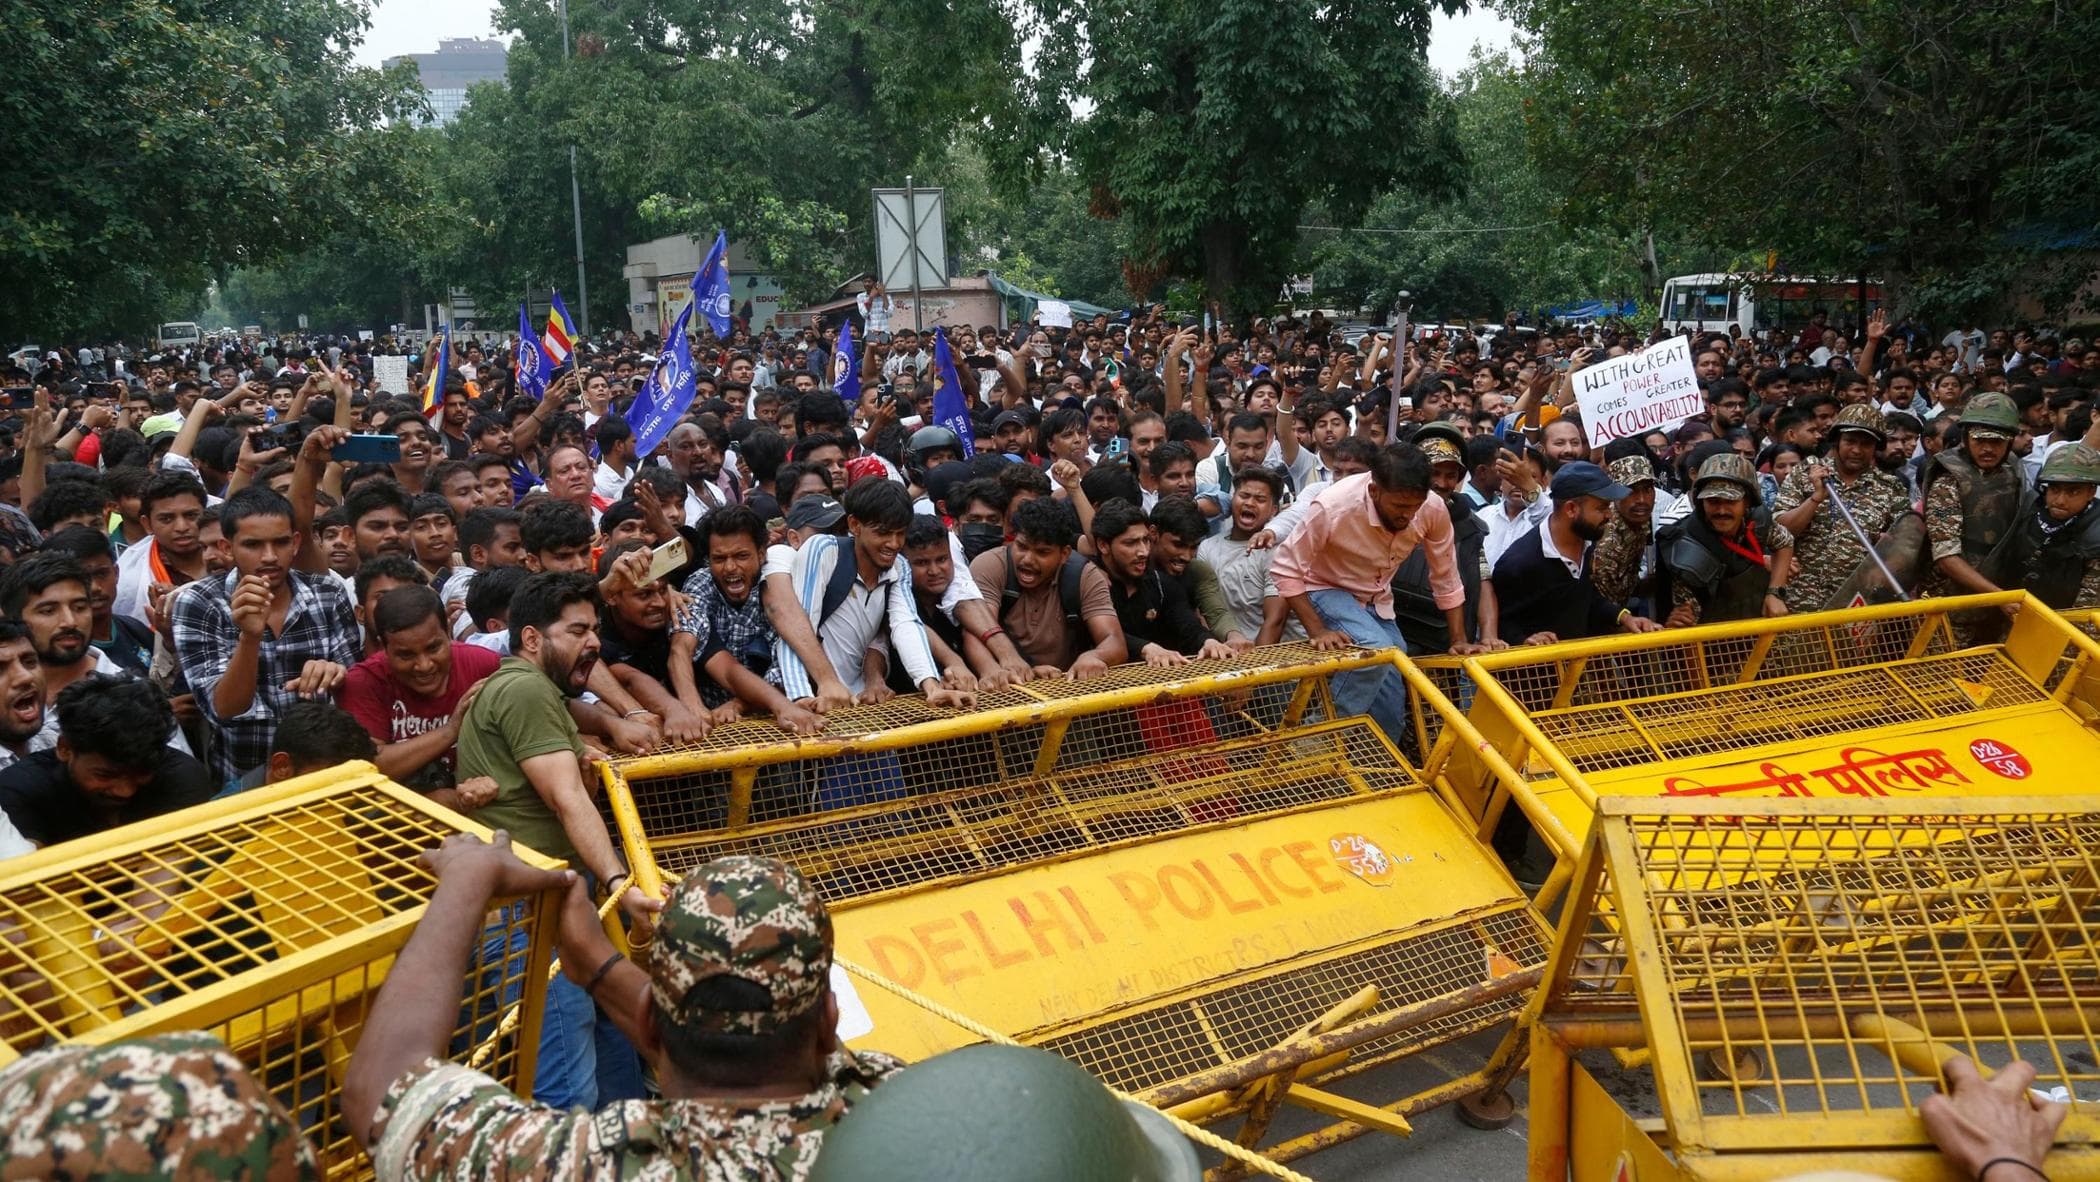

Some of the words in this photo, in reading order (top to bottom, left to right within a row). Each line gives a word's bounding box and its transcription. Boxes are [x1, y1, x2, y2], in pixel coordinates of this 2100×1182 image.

[1584, 362, 1629, 392] WITH
[1632, 345, 1686, 373] GREAT
[1623, 373, 1661, 393] POWER
[1597, 396, 1628, 414] COMES
[1646, 377, 1692, 398] GREATER
[1594, 392, 1699, 445] ACCOUNTABILITY
[1994, 759, 2025, 777] 58
[865, 885, 1106, 990] DELHI
[1107, 841, 1346, 933] POLICE
